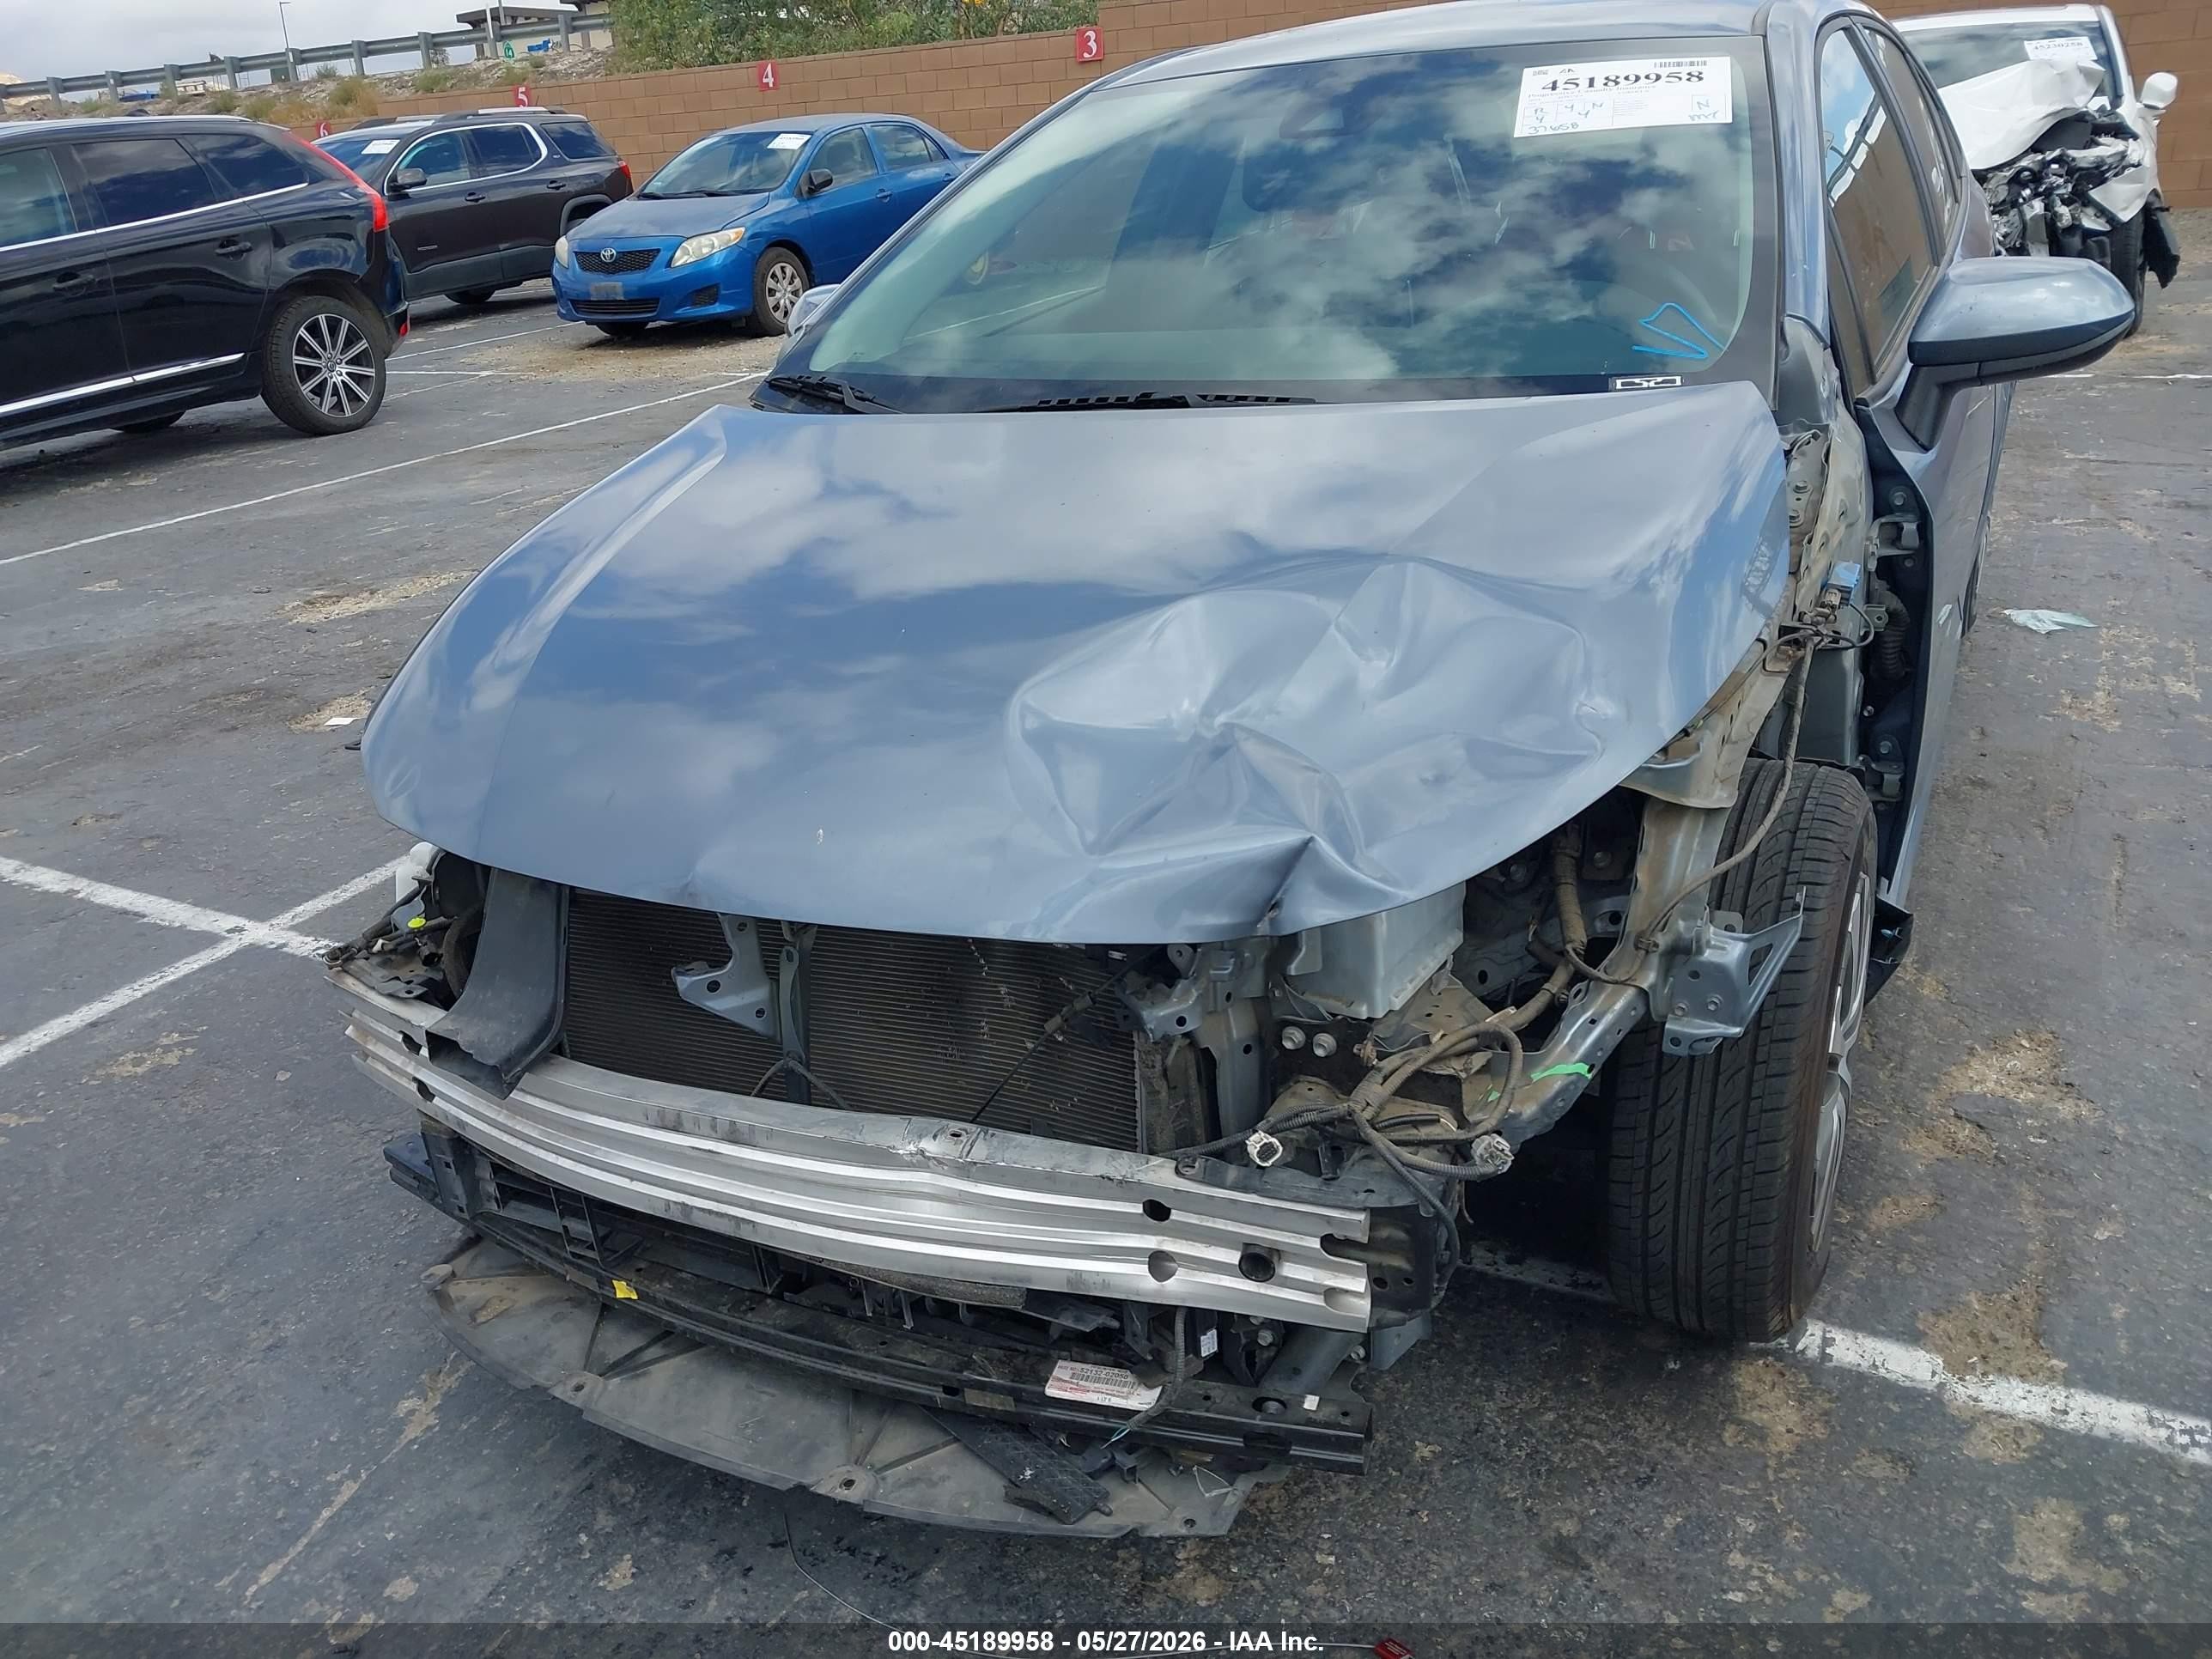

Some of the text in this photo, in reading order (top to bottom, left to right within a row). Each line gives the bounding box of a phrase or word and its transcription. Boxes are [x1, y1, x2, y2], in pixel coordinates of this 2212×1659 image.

[1083, 30, 1097, 58] 3
[763, 63, 774, 88] 4
[1541, 70, 1705, 92] 45189958
[518, 87, 528, 107] 5
[319, 122, 329, 137] 6
[1079, 1366, 1129, 1380] 52132-02050
